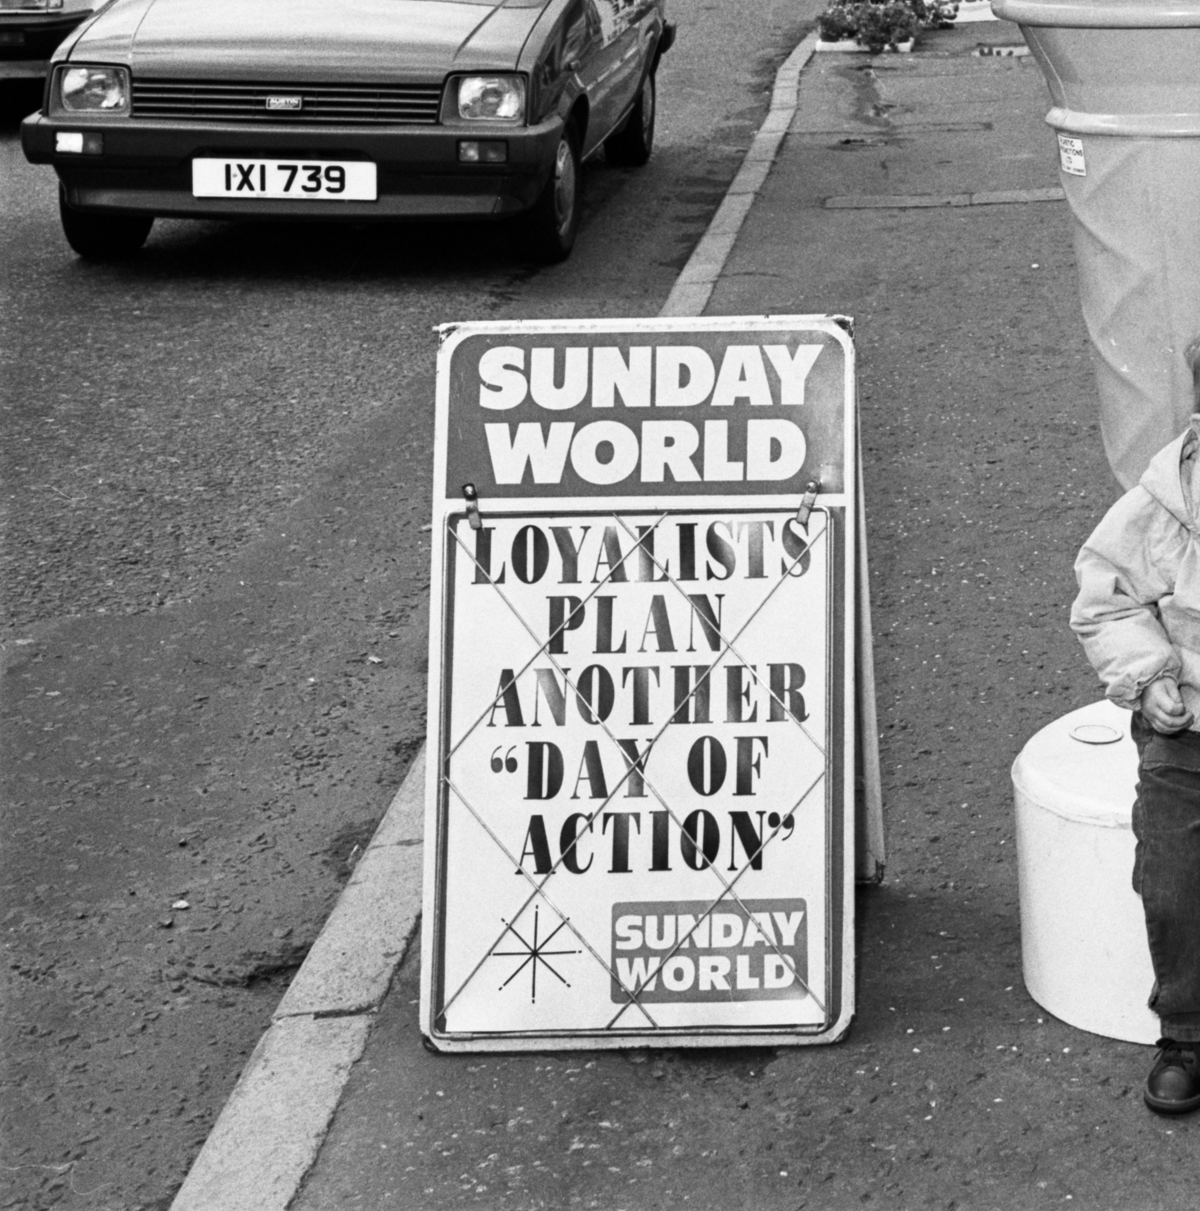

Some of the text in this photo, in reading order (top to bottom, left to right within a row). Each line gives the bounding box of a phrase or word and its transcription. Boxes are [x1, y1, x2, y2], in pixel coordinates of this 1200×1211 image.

[225, 163, 346, 194] IXI 739
[477, 343, 824, 411] SUNDAY
[484, 418, 807, 486] WORLD
[470, 516, 813, 586] LOYALISTS
[545, 593, 726, 656] PLAN
[486, 661, 811, 729] ANOTHER
[686, 734, 770, 798] OF
[614, 910, 806, 951] SUNDAY
[616, 953, 798, 994] WORLD
